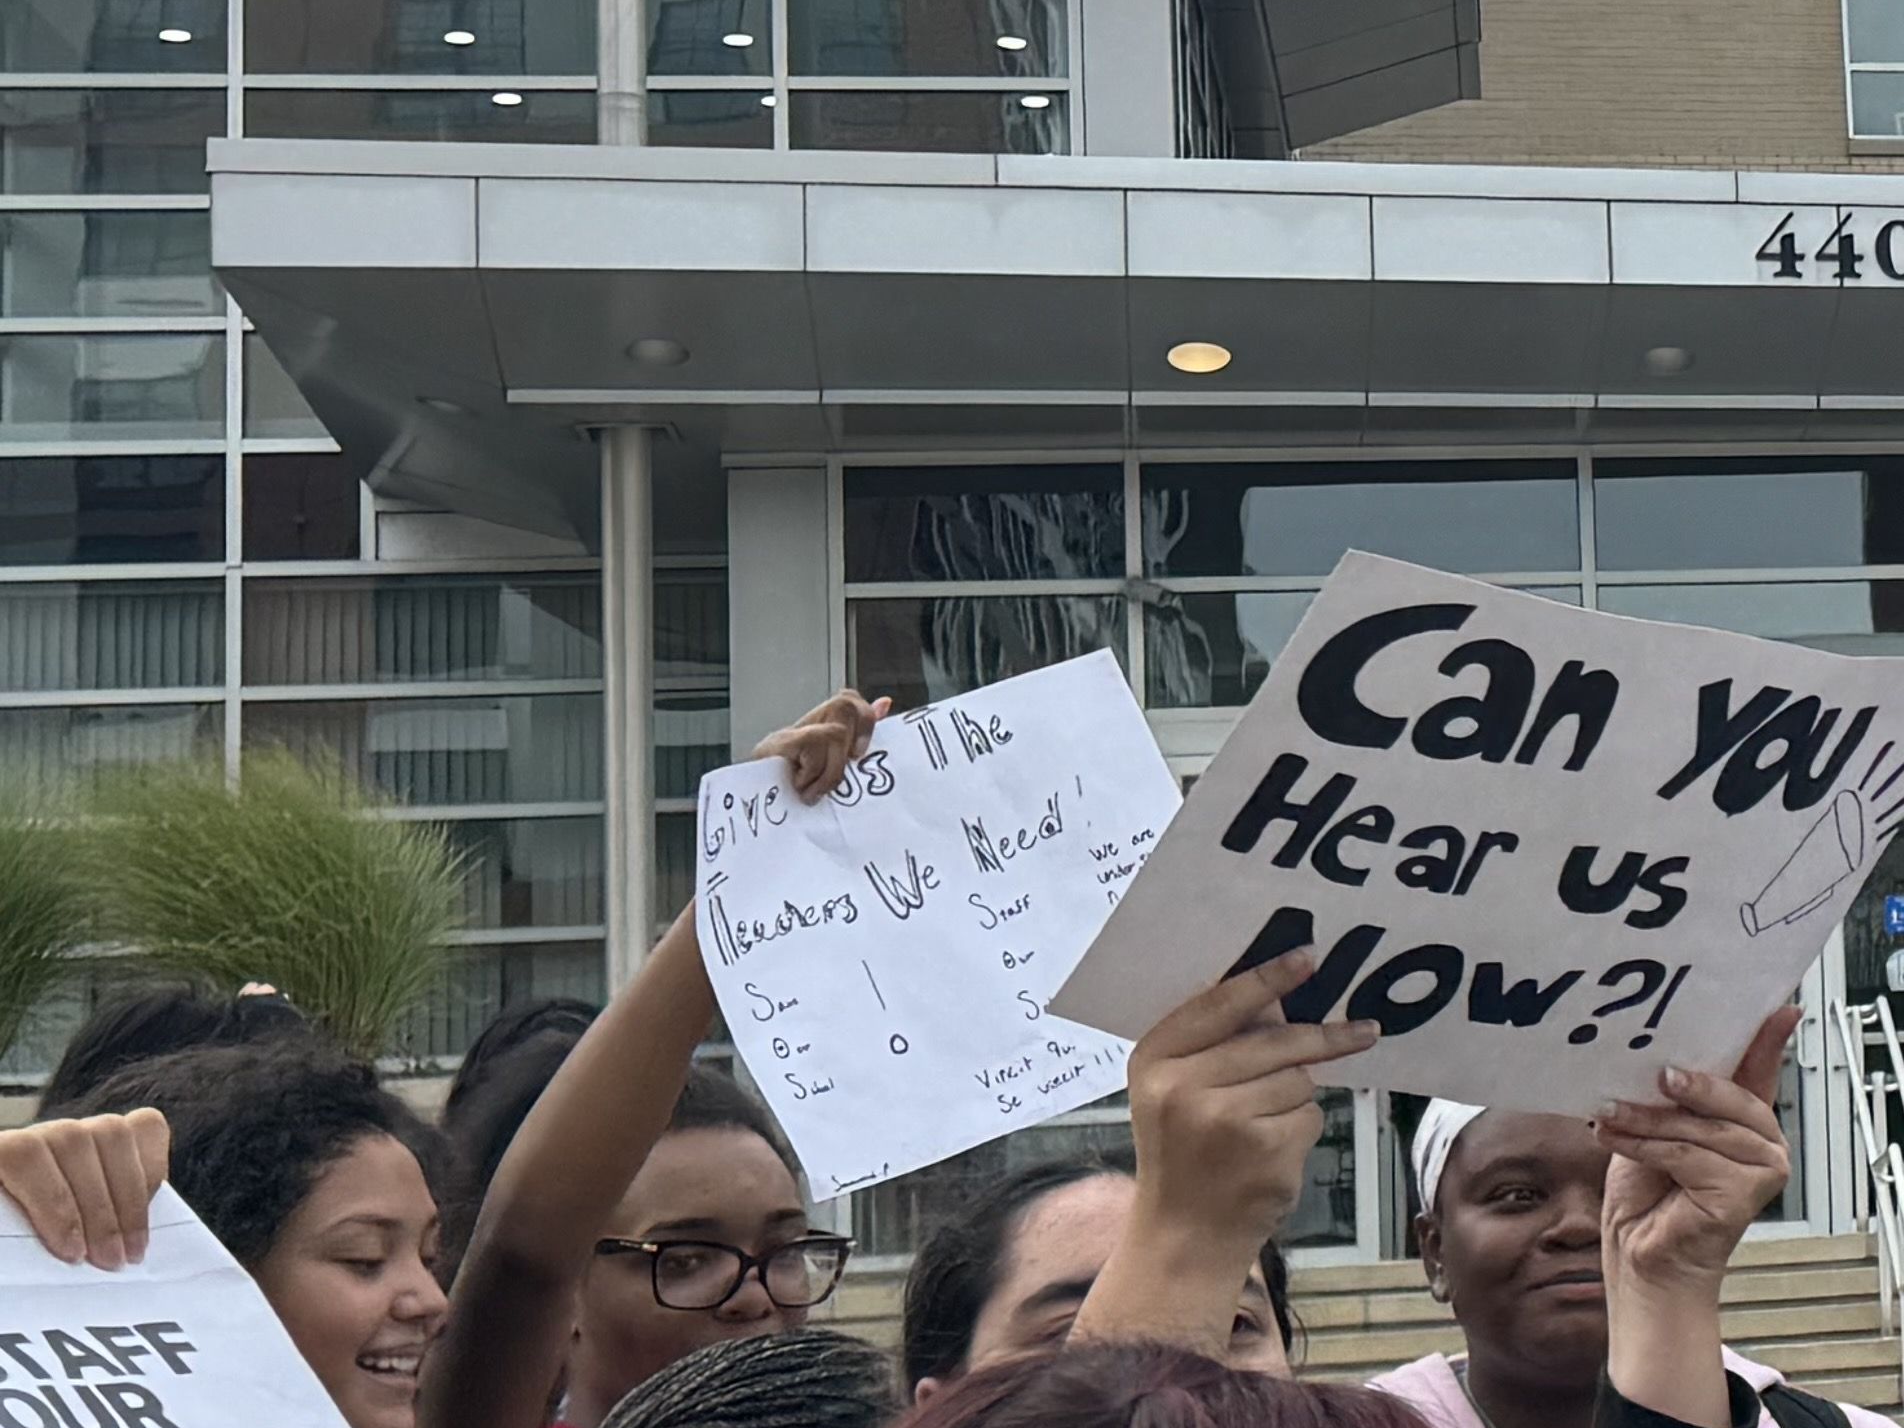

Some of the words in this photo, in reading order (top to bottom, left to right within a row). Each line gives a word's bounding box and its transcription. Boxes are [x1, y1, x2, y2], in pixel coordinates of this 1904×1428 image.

[1297, 603, 1620, 771] Can
[903, 706, 1014, 771] The
[1220, 752, 1520, 897] Hear
[1557, 845, 1691, 929] us
[864, 848, 941, 921] We
[0, 1321, 198, 1382] TAFF
